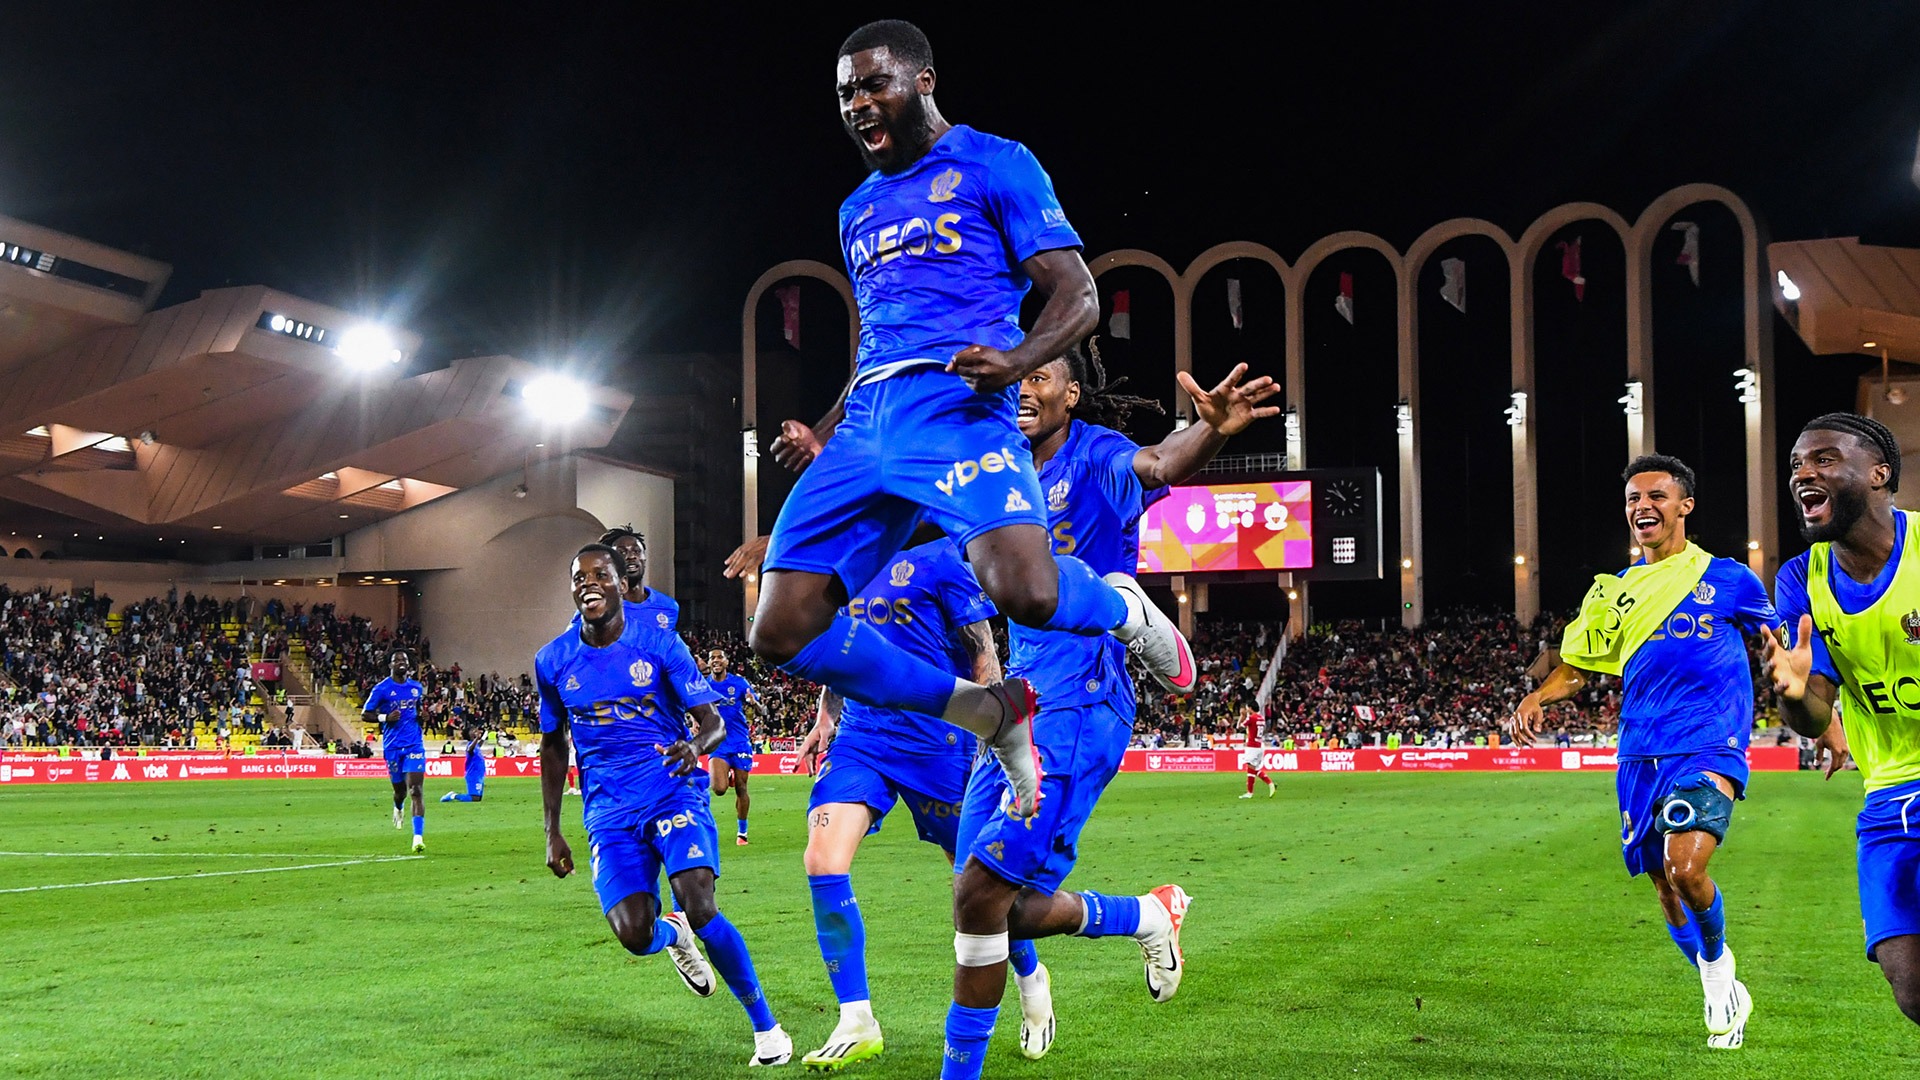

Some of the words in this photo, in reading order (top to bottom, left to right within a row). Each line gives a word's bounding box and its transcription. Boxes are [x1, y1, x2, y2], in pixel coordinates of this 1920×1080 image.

[1041, 208, 1066, 223] INE
[935, 447, 1021, 497] vbet
[838, 596, 913, 626] EOS
[1321, 751, 1355, 761] TEDDY
[1401, 751, 1469, 761] CUPRA
[142, 763, 169, 778] vbet
[241, 765, 265, 774] BANG
[266, 765, 274, 774] &
[424, 760, 453, 776] COM
[1321, 761, 1355, 771] SMITH
[919, 800, 963, 818] vbe
[656, 809, 698, 838] bet
